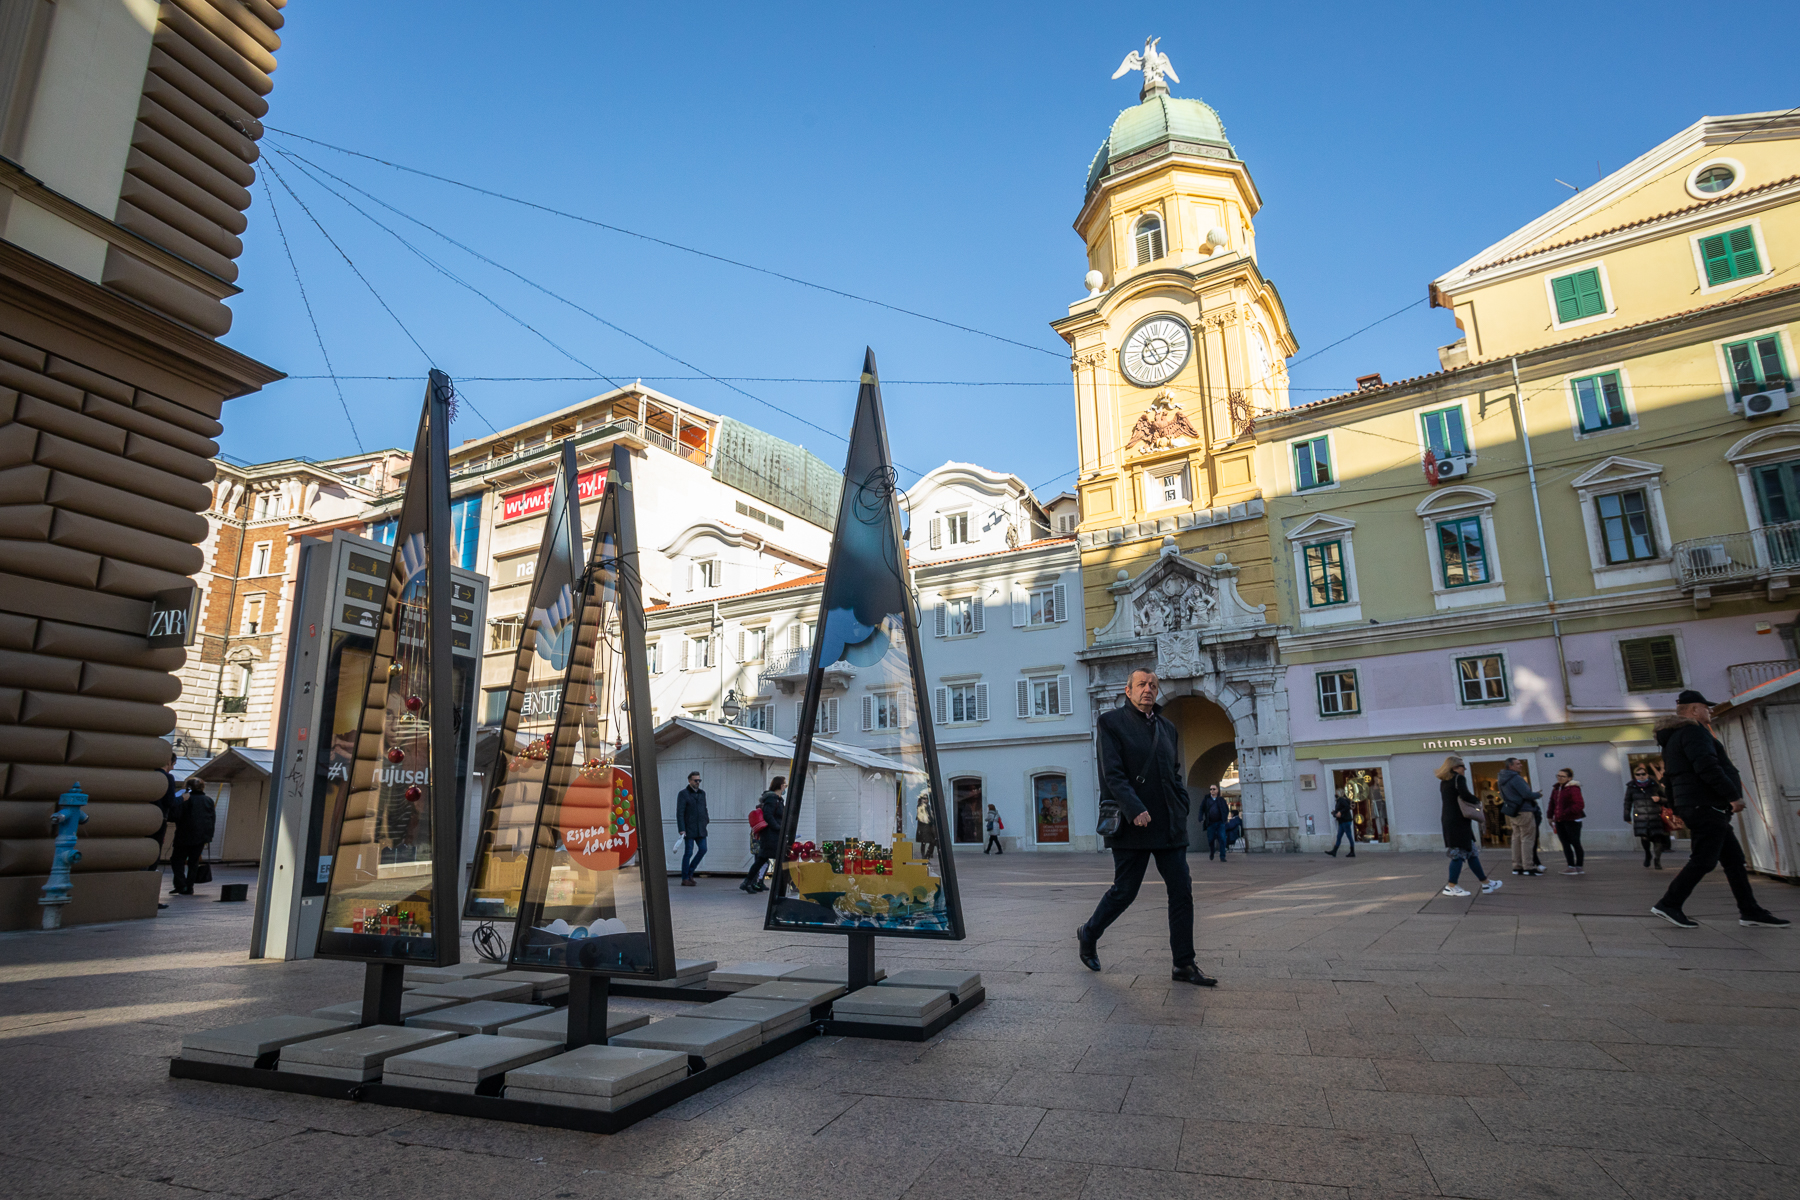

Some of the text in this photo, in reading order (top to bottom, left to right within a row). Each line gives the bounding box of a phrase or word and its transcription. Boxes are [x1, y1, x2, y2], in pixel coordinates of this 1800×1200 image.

[1165, 490, 1175, 500] 15
[150, 609, 188, 636] ZARA
[1422, 736, 1513, 749] intimissimi
[566, 826, 605, 844] Rijeka
